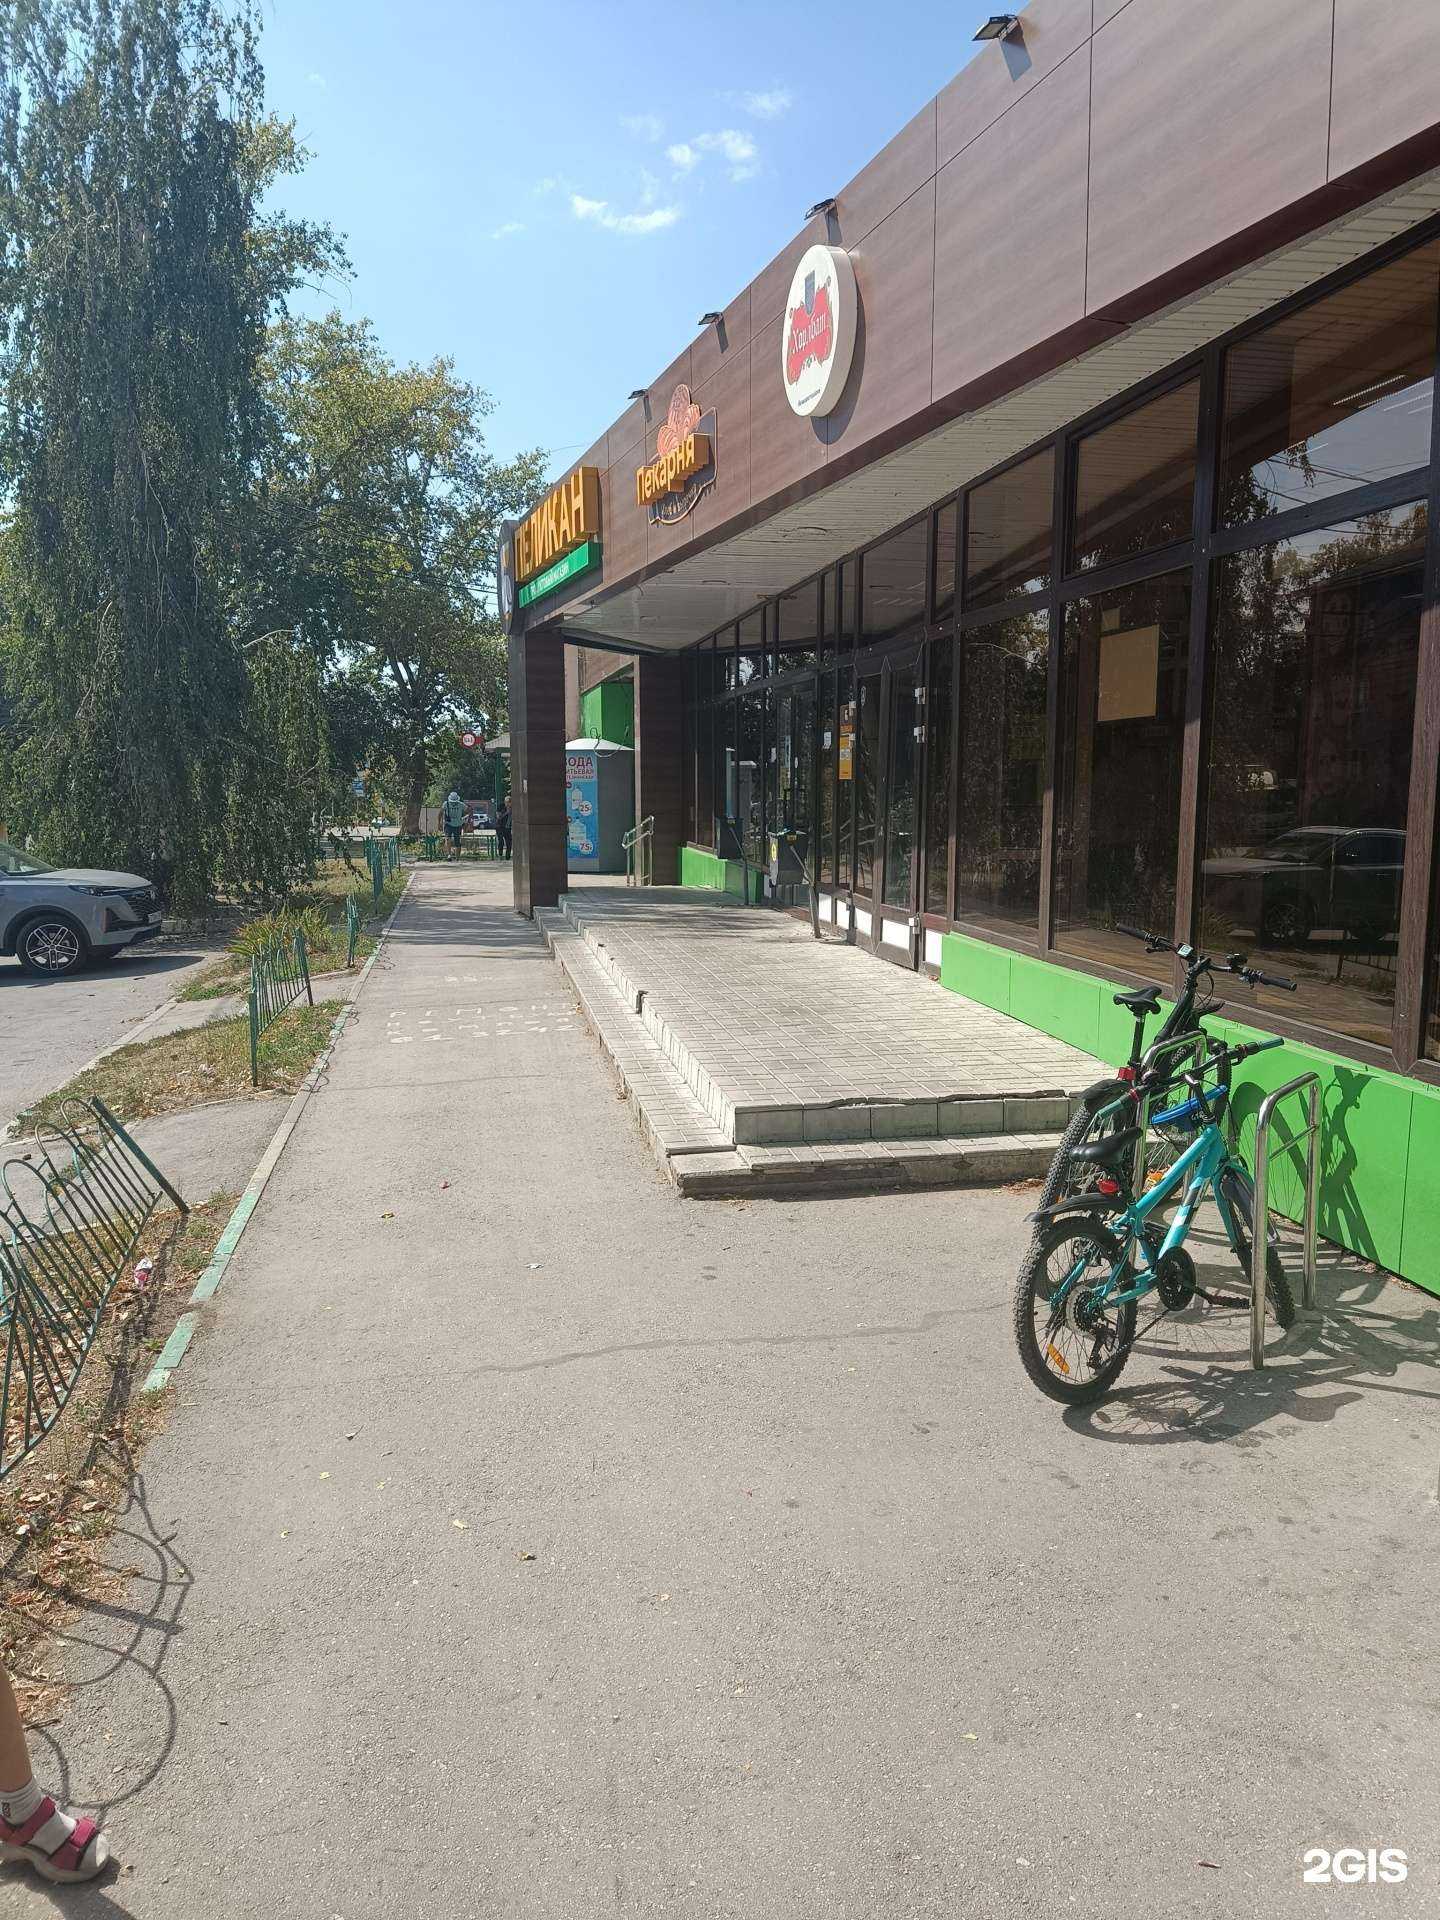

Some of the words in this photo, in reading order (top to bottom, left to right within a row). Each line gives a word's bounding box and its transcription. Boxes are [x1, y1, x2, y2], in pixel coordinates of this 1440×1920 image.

[636, 435, 695, 503] Пекарня
[515, 469, 584, 580] ПЕЛИКАН
[566, 757, 593, 768] ОДА
